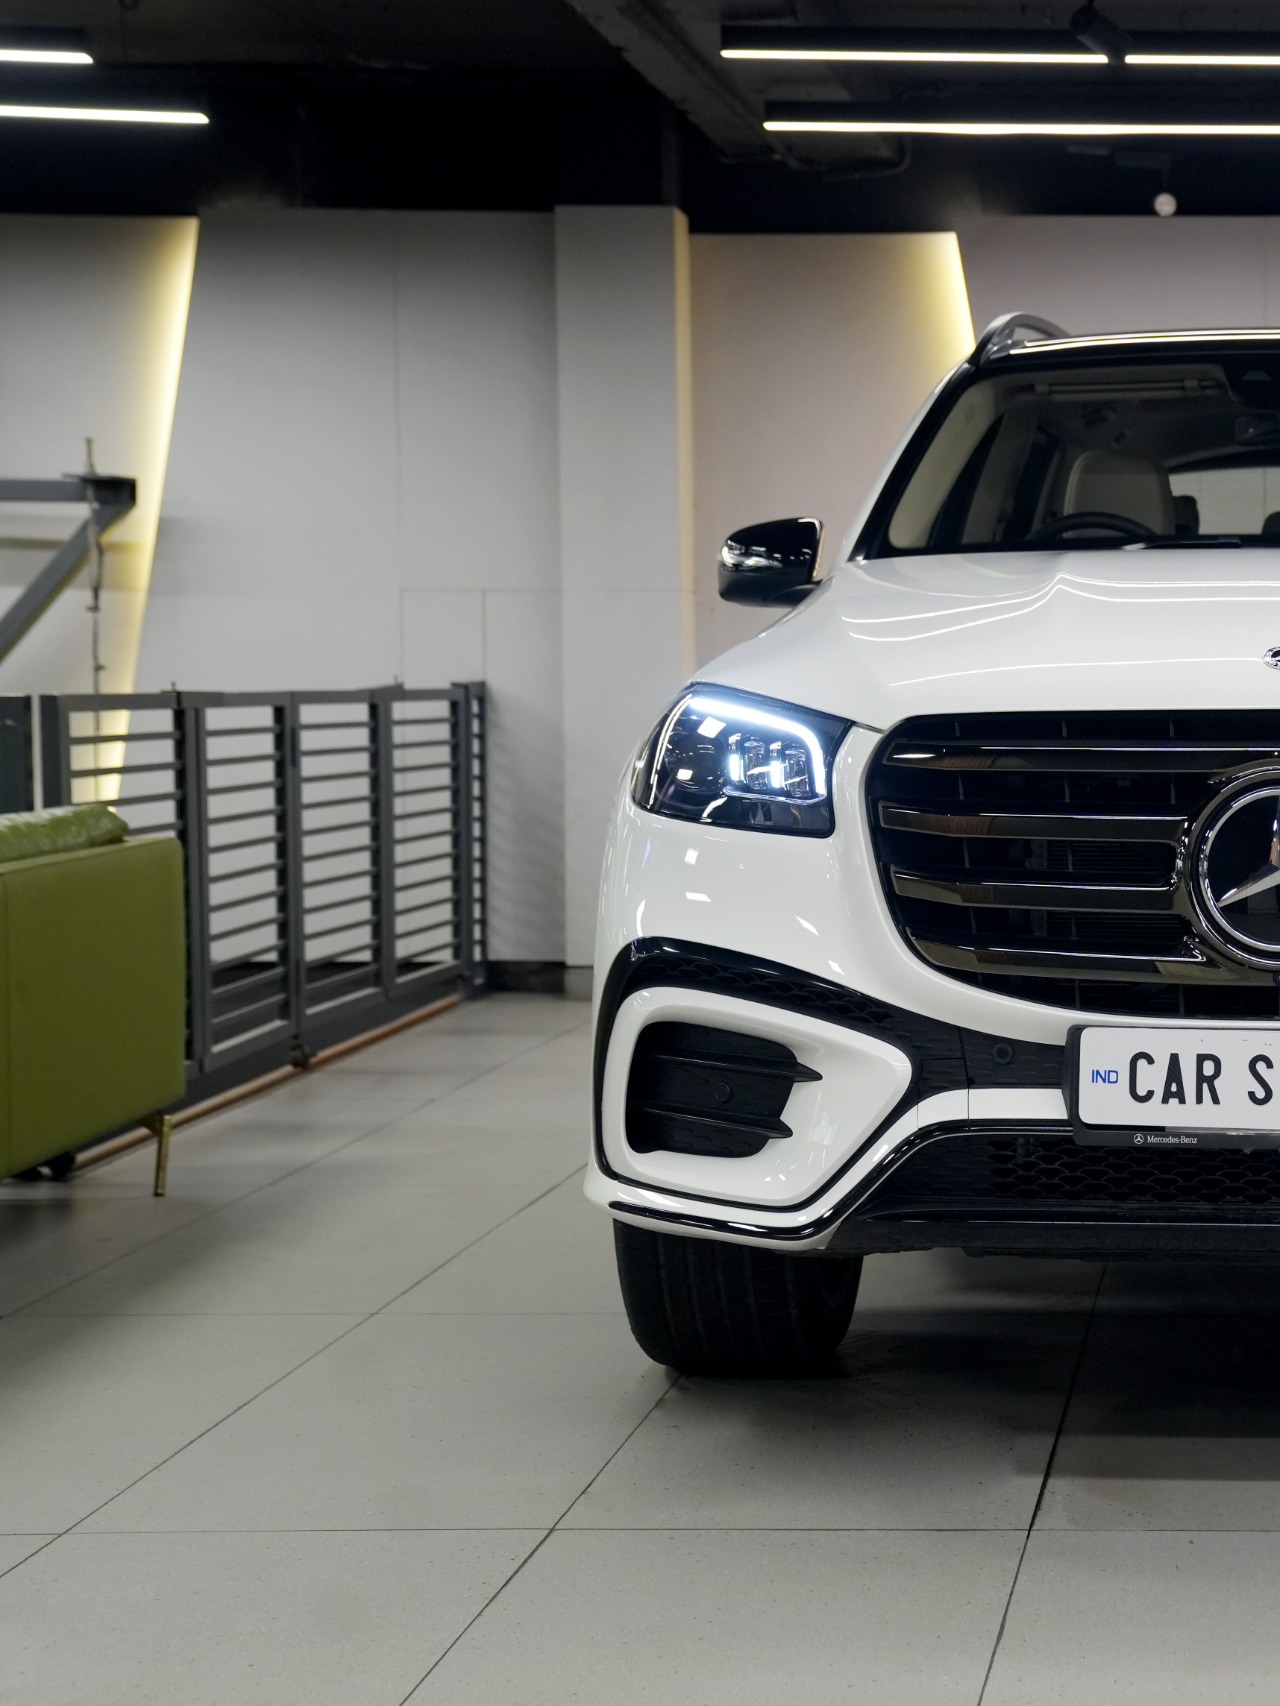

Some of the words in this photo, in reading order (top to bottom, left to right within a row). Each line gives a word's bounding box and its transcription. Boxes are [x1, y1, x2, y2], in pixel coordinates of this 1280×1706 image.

[1091, 1069, 1119, 1084] IND
[1129, 1052, 1221, 1104] CAR
[1147, 1135, 1198, 1144] Mercedes-Benz
